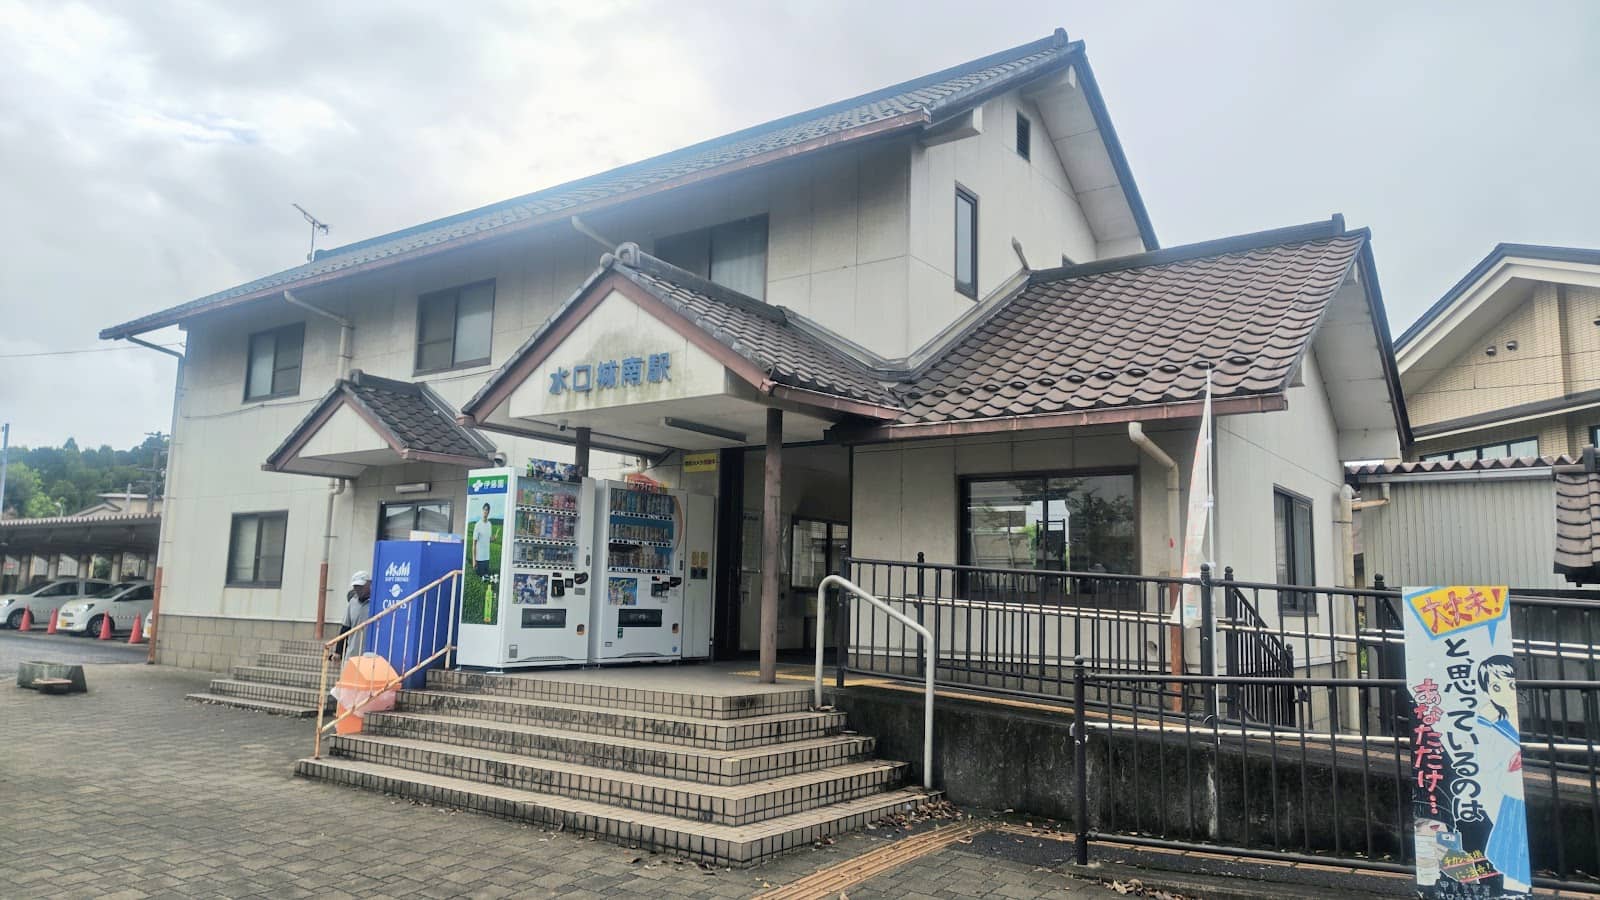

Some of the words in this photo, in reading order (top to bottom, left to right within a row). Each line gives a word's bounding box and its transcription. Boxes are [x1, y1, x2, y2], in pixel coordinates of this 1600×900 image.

[549, 352, 672, 395] 水口城南駅
[385, 561, 411, 577] Asahi
